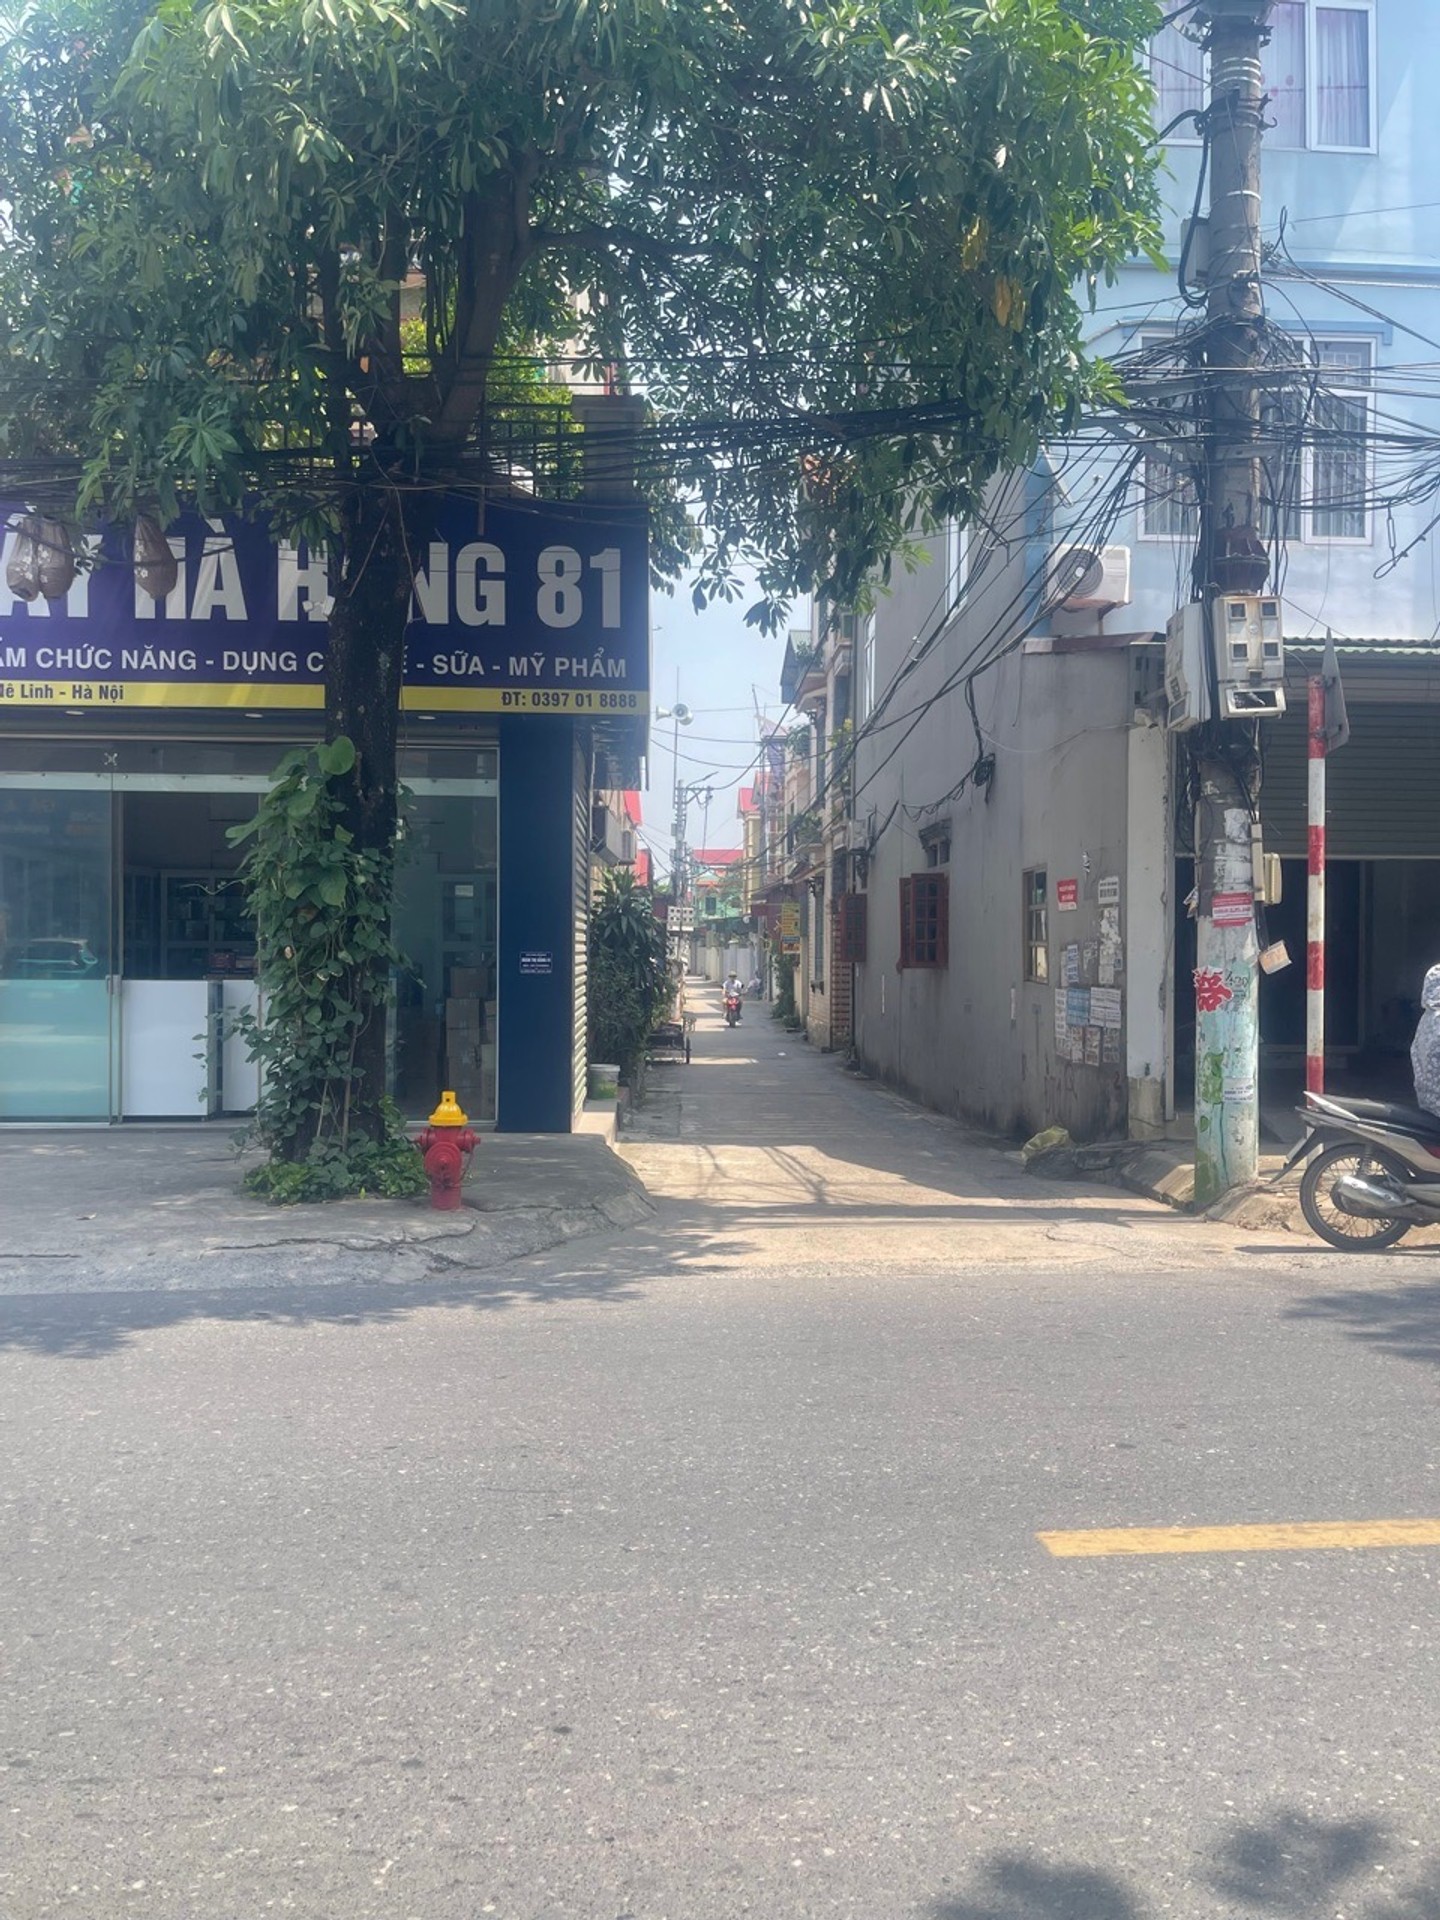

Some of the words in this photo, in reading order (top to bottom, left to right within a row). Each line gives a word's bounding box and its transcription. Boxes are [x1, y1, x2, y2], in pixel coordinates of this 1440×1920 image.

[278, 538, 506, 626] HNG
[537, 545, 621, 628] 81
[0, 637, 26, 668] M
[36, 643, 112, 669] CHỨC
[121, 645, 197, 671] NĂNG
[223, 651, 297, 675] DỤNG
[432, 650, 485, 675] SỮA
[508, 653, 547, 677] MỸ
[555, 647, 627, 678] PHẨM
[21, 684, 53, 699] Linh
[99, 684, 124, 703] Nội
[501, 691, 526, 707] ĐT:
[531, 692, 570, 708] 0397
[575, 693, 593, 708] 01
[599, 693, 637, 708] 8888
